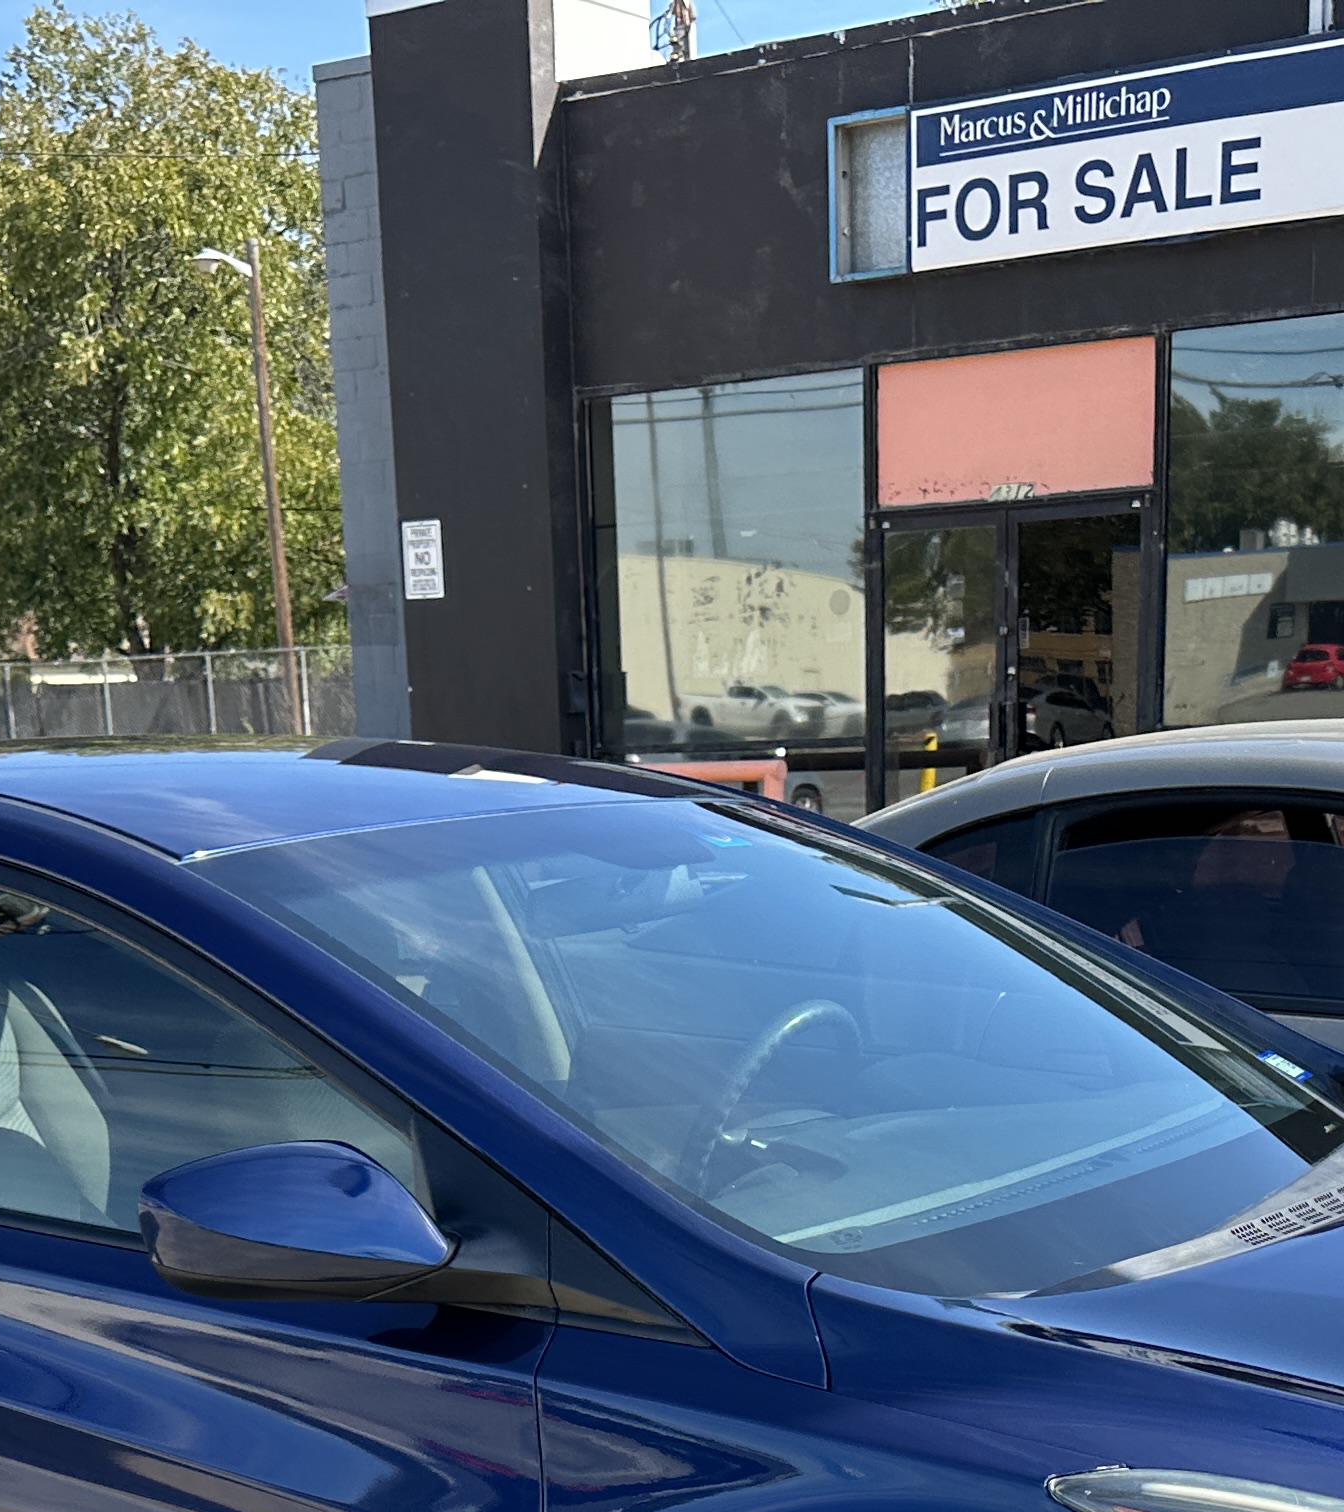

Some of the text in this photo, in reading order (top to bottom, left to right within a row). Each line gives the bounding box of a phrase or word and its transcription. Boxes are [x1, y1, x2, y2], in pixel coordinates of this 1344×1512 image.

[939, 86, 1172, 146] Marcus & Millichap
[916, 136, 1262, 248] FOR SALE
